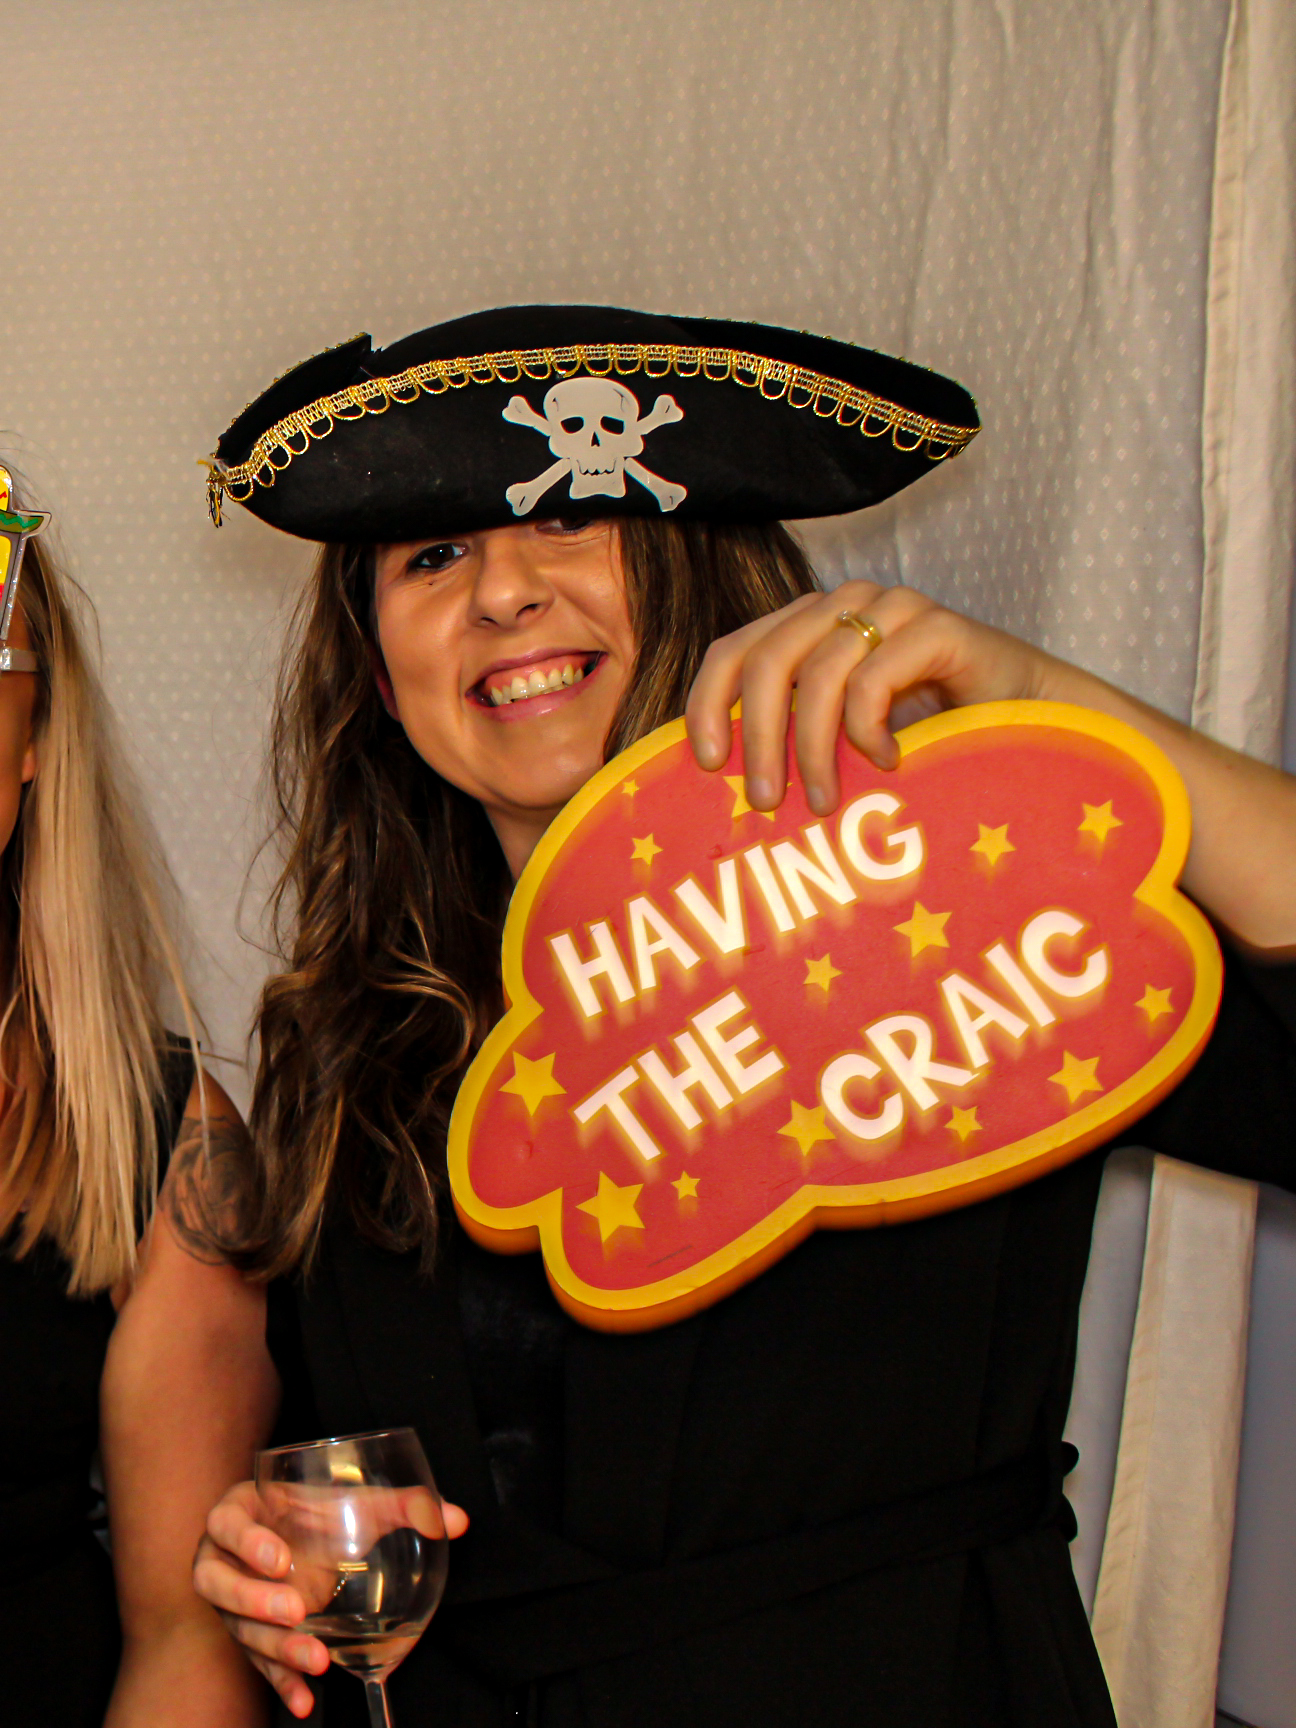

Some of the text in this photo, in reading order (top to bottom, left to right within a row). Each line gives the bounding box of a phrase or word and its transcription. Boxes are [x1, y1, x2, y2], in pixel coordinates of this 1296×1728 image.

[549, 792, 924, 1019] HAVING
[573, 990, 785, 1162] THE
[820, 910, 1109, 1141] CRAIC
